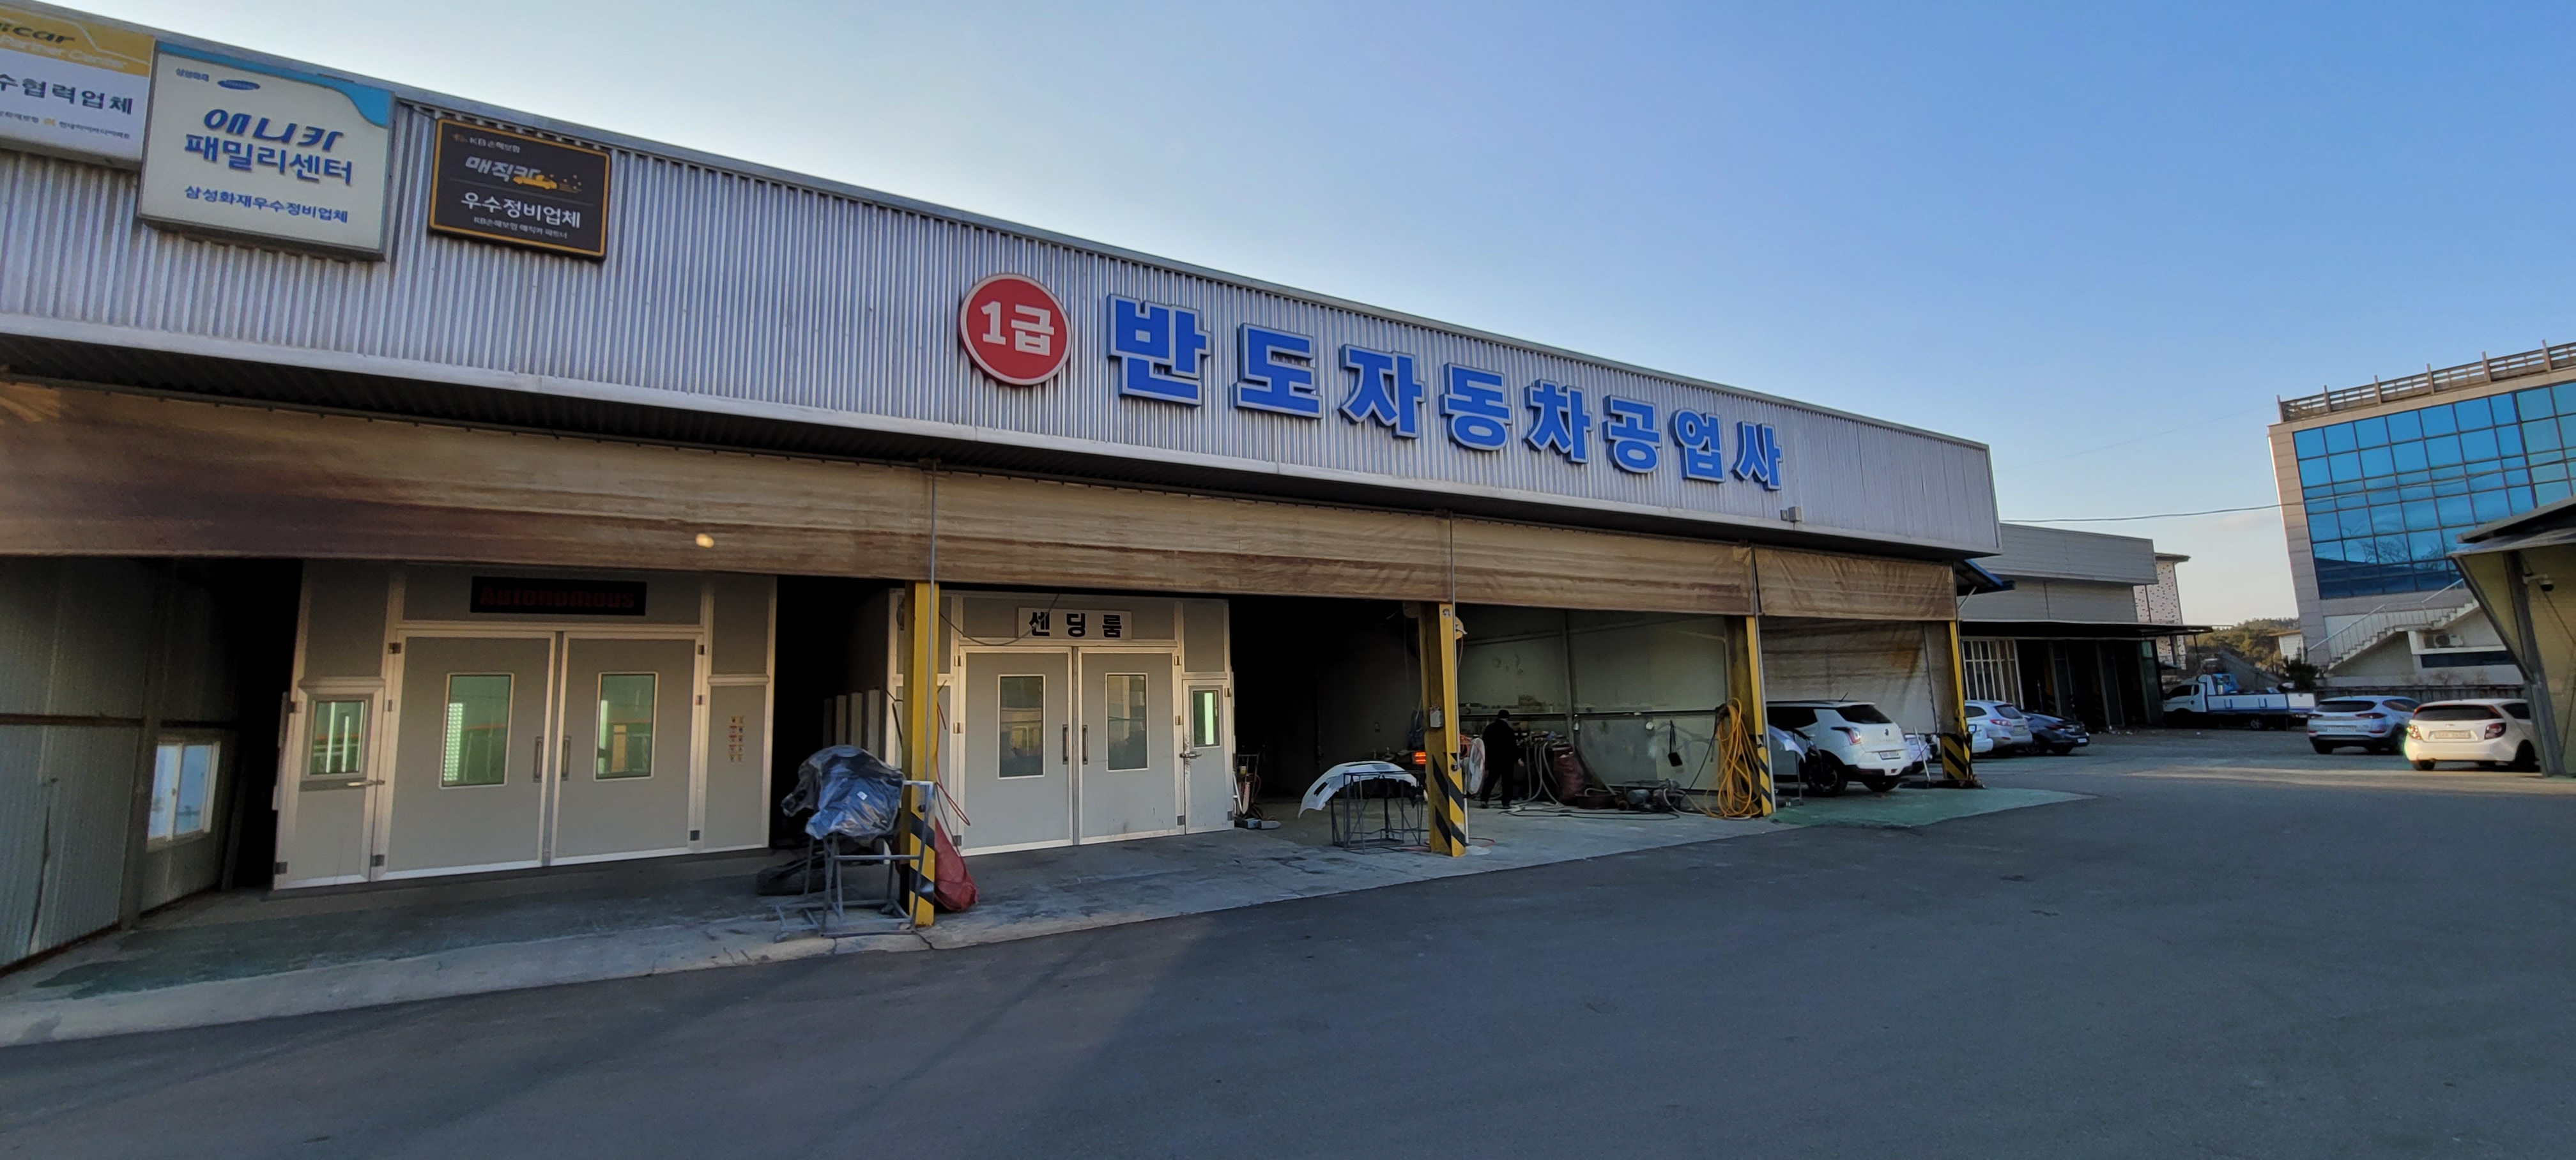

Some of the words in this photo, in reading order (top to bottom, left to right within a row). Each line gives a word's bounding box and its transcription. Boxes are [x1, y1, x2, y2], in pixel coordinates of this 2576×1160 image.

[0, 22, 75, 43] icar
[204, 109, 344, 153] 애니카
[185, 134, 353, 187] 패밀리센터
[185, 185, 348, 224] 삼성화재우수정비업체
[461, 192, 581, 229] 우수정비업체
[980, 300, 1055, 356] 1급
[1107, 293, 1784, 491] 반도자동차공업사
[480, 584, 634, 607] Autonomous
[1029, 611, 1123, 638] 센딩룸
